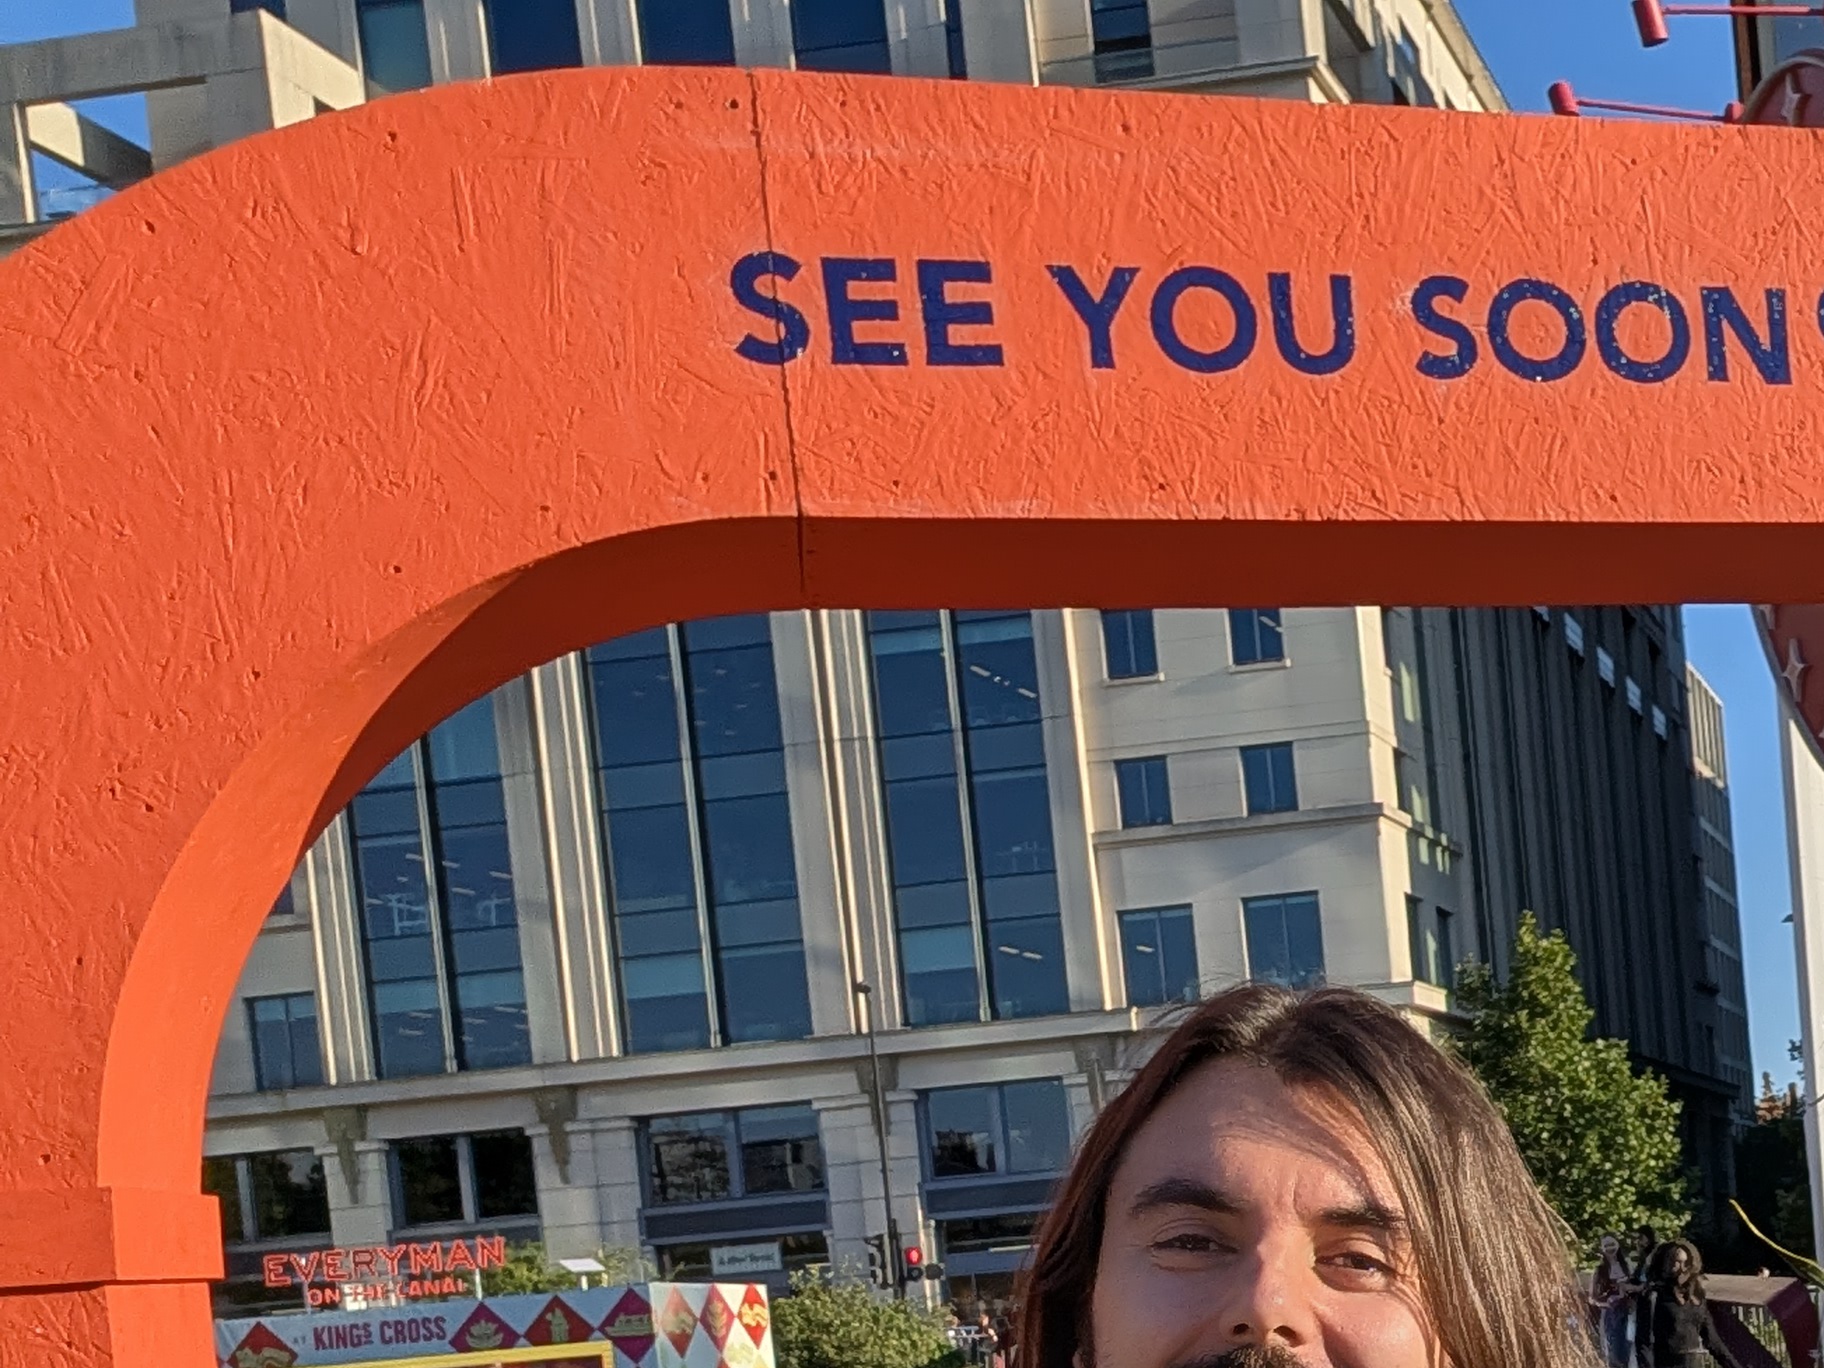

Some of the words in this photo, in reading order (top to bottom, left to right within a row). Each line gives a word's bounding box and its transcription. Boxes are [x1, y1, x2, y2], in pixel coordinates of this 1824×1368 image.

[730, 250, 1005, 367] SEE
[1045, 264, 1356, 377] YOU
[1409, 274, 1793, 386] SOON
[262, 1234, 506, 1288] EVERYMAN
[307, 1287, 341, 1306] ON
[379, 1315, 447, 1346] CROSS
